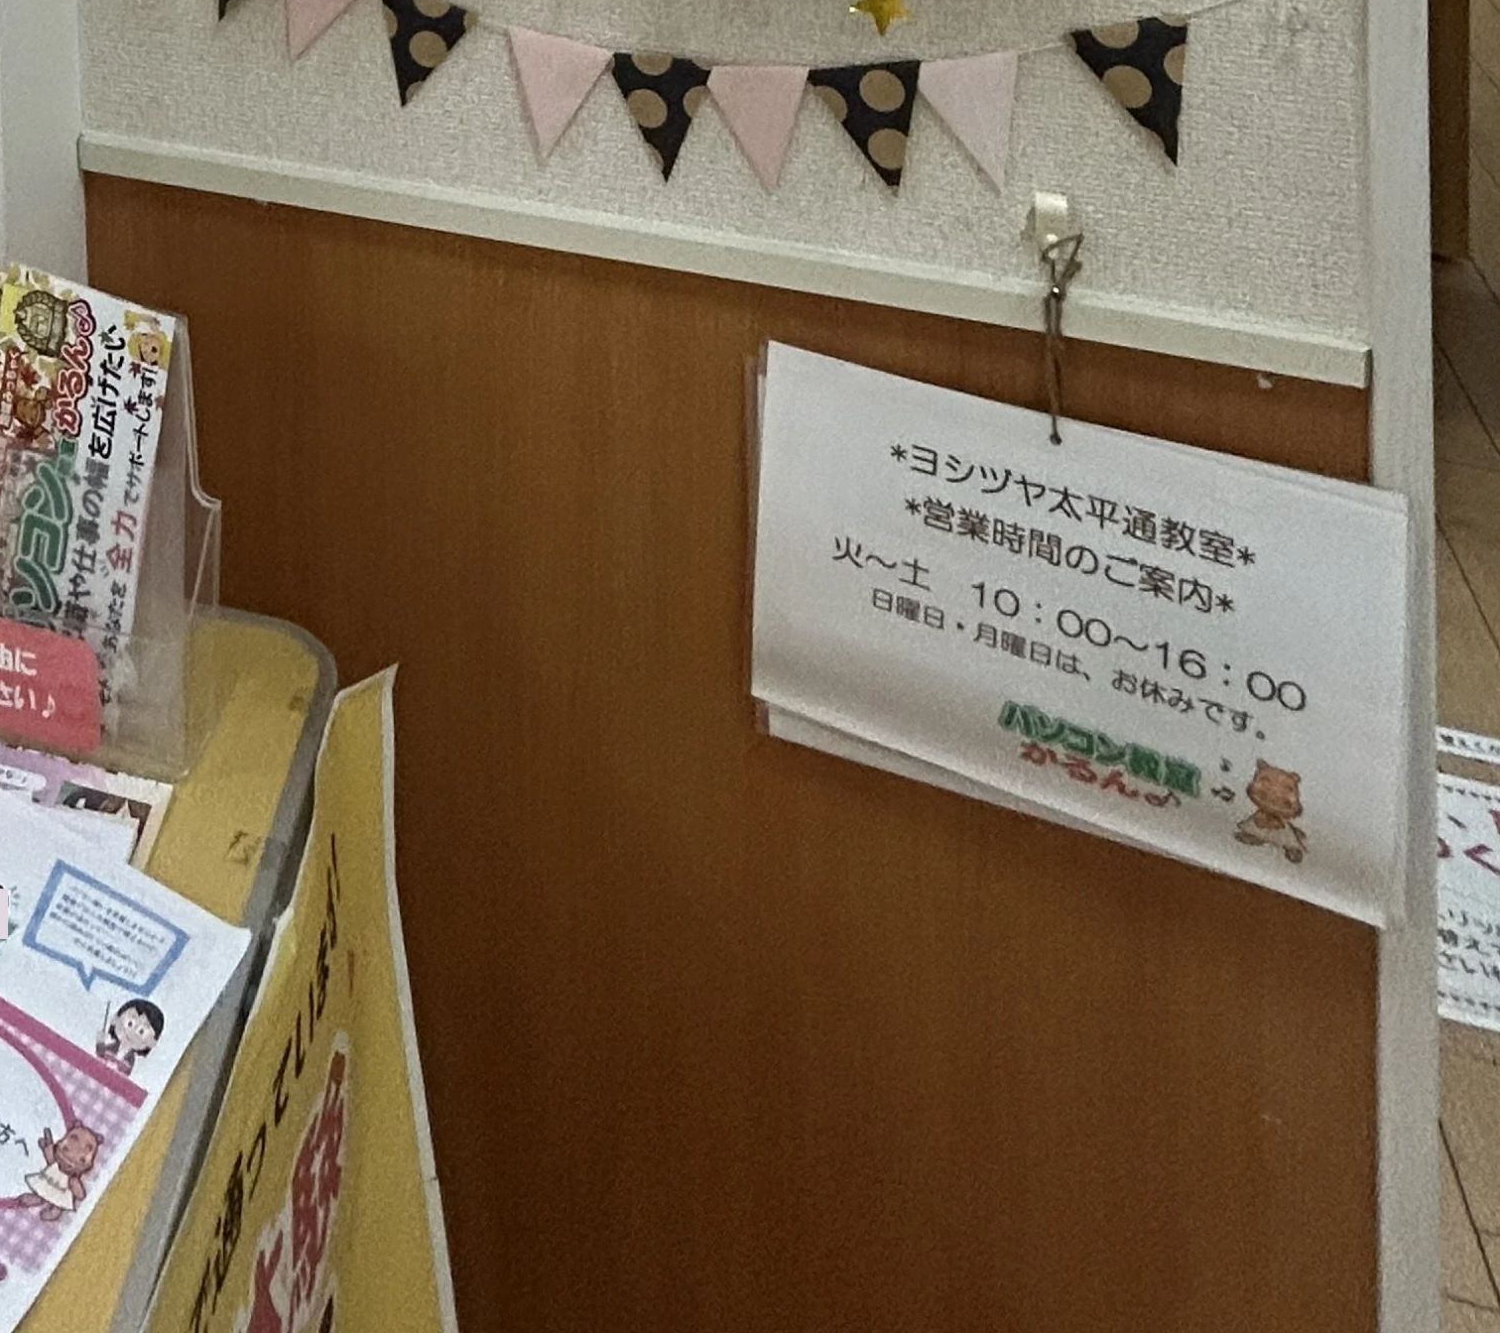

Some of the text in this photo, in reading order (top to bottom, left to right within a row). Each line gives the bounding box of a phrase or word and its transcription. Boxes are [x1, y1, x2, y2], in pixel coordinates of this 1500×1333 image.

[11, 461, 78, 616] ソコン
[870, 587, 1267, 740] 日曜日・月曜日は、お休みです。
